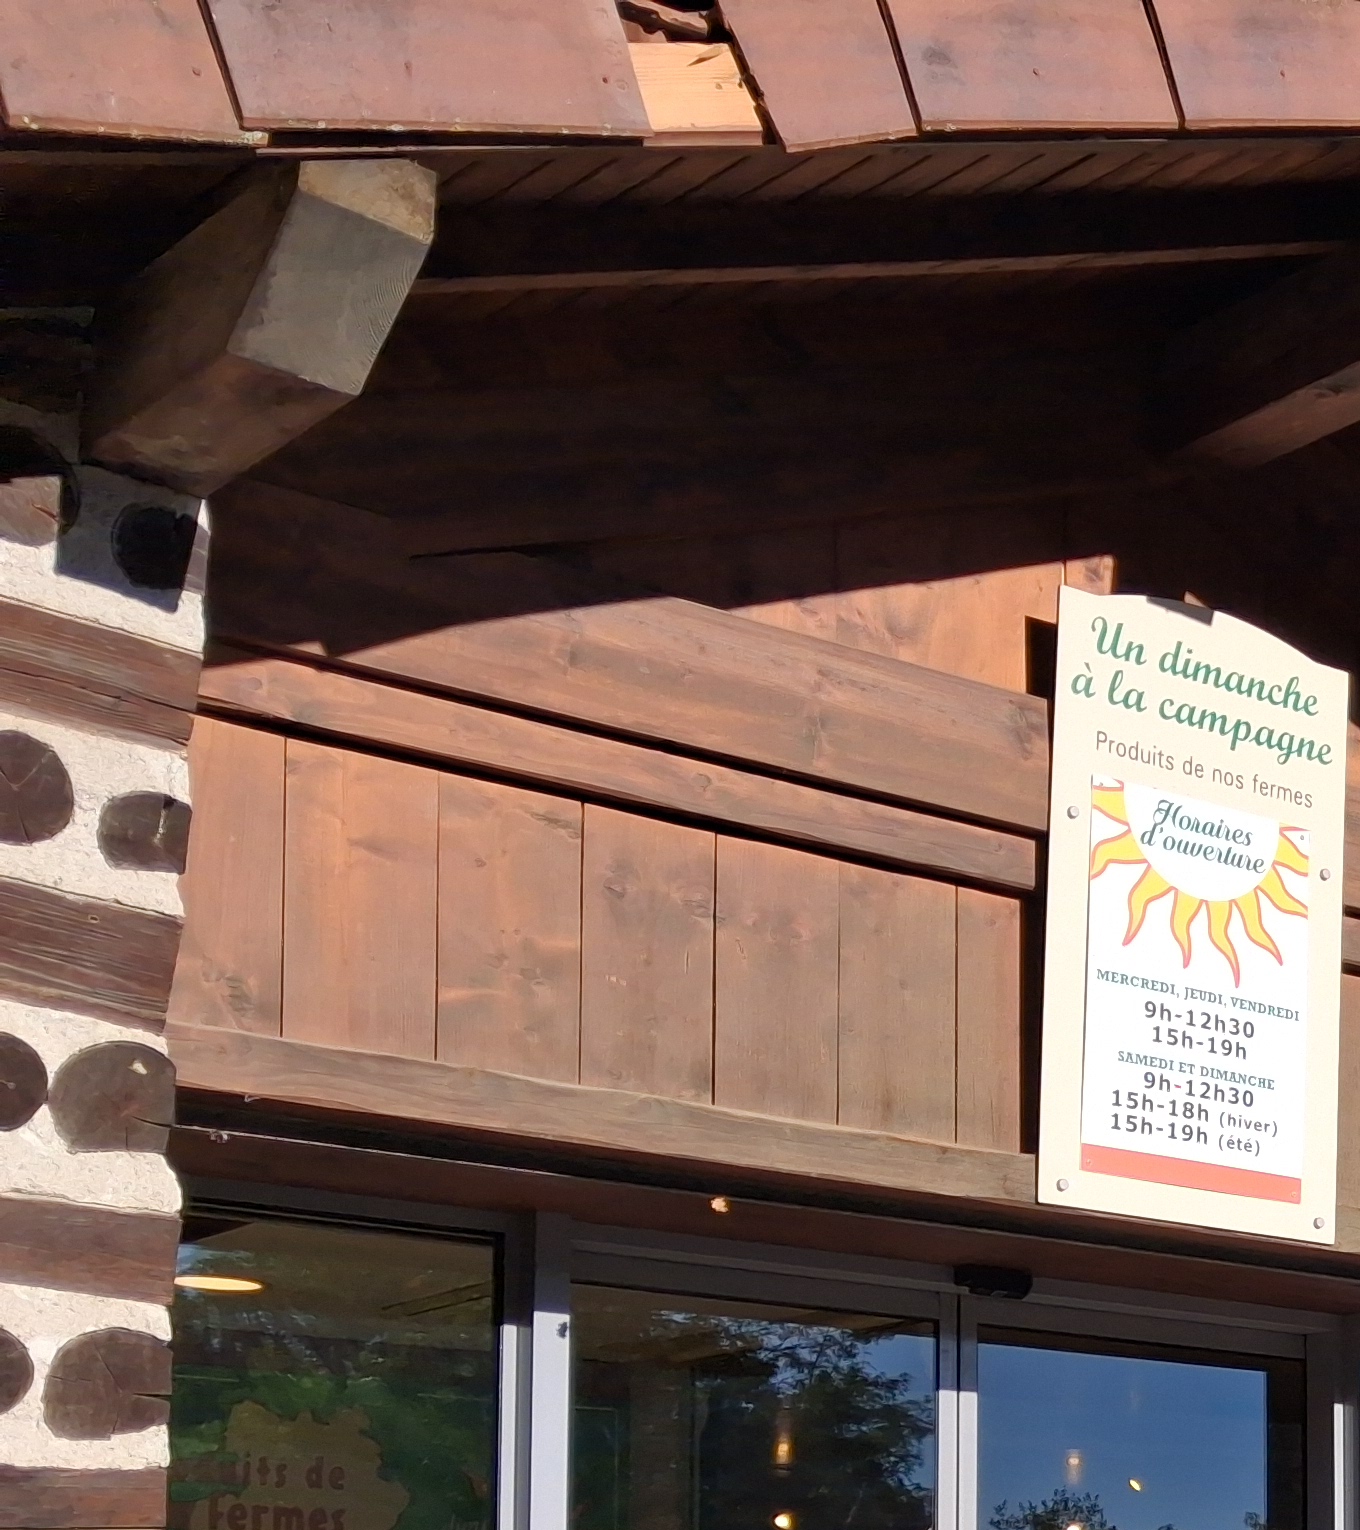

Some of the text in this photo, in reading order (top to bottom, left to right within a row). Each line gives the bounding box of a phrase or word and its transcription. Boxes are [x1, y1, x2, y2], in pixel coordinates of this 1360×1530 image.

[1091, 616, 1319, 716] Un dimanche
[1071, 661, 1333, 765] à la campagne
[1096, 730, 1313, 809] Produits de nos fermes
[1152, 799, 1252, 847] Horaires
[1097, 968, 1300, 1022] MERCREDI, JEUDI, VENDREDI
[1144, 1000, 1255, 1039] 9h-12h30
[1152, 1025, 1247, 1060] 15h-19h
[1117, 1050, 1275, 1091] SAMEDI ET DIMANCHE
[1143, 1072, 1254, 1108] 9h-12h30
[1110, 1113, 1260, 1156] 15h-19h (été)
[1111, 1090, 1278, 1137] 15h-18h (hiver)
[305, 1455, 346, 1490] de
